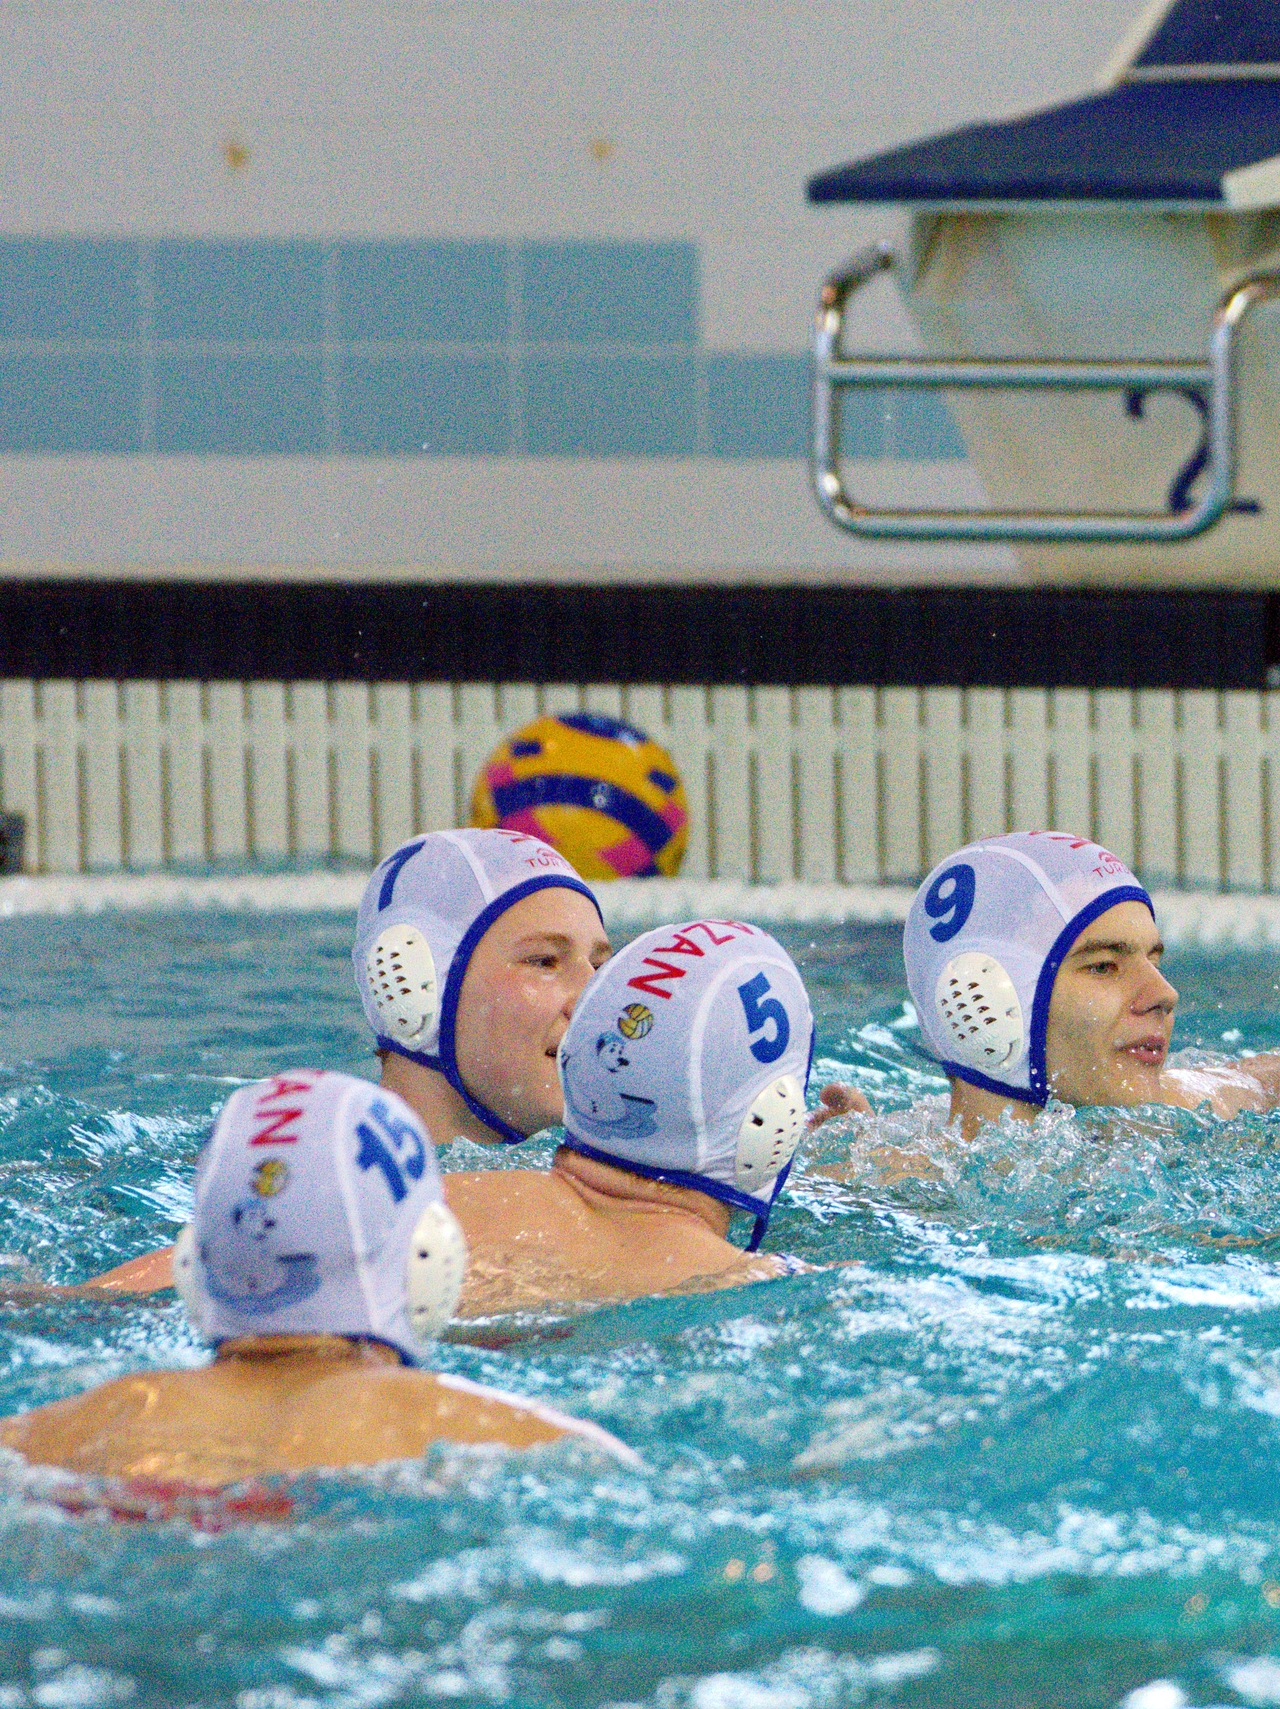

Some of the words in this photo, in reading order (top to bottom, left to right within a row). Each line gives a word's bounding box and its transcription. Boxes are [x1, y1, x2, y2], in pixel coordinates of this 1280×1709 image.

[377, 840, 427, 913] 7
[924, 863, 976, 944] 9
[737, 971, 791, 1065] 5
[356, 1099, 427, 1204] 15
